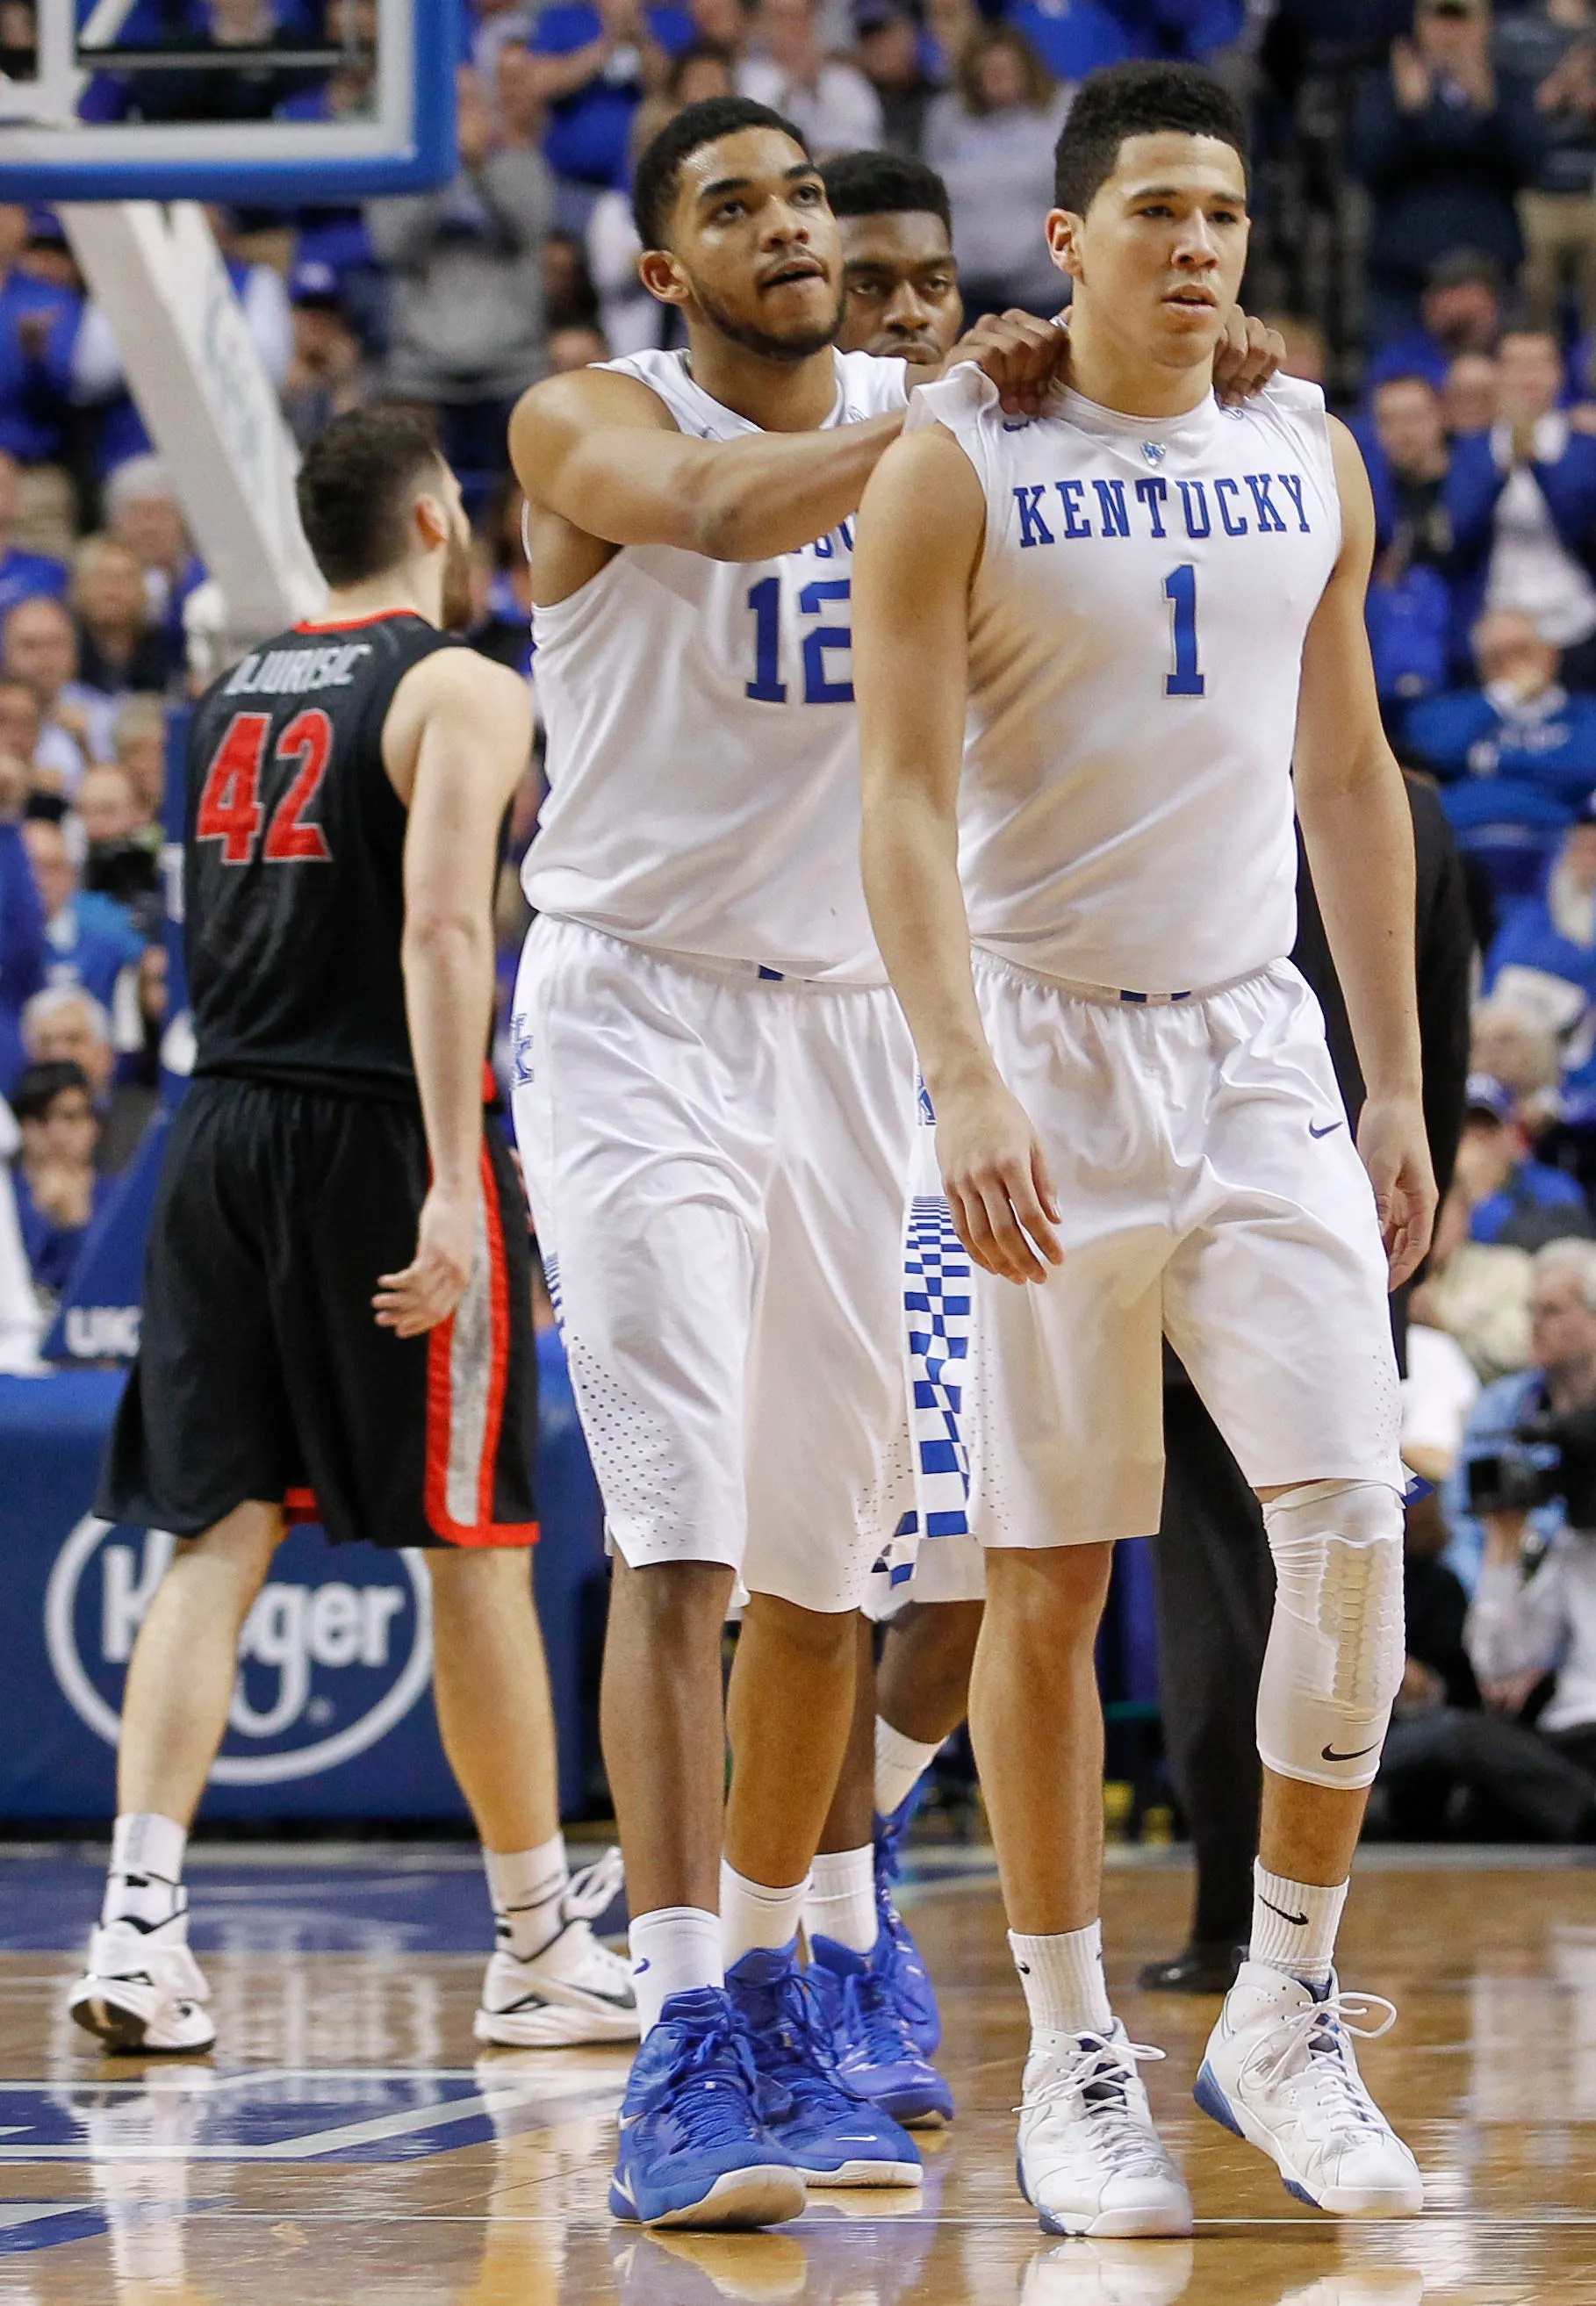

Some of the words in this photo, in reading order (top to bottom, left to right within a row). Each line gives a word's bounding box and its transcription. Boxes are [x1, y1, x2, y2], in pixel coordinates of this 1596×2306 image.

[1013, 474, 1311, 548] KENTUCKY
[746, 577, 855, 703] 12
[1164, 564, 1204, 698] 1
[197, 708, 334, 865] 42
[102, 1529, 404, 1736] Kger
